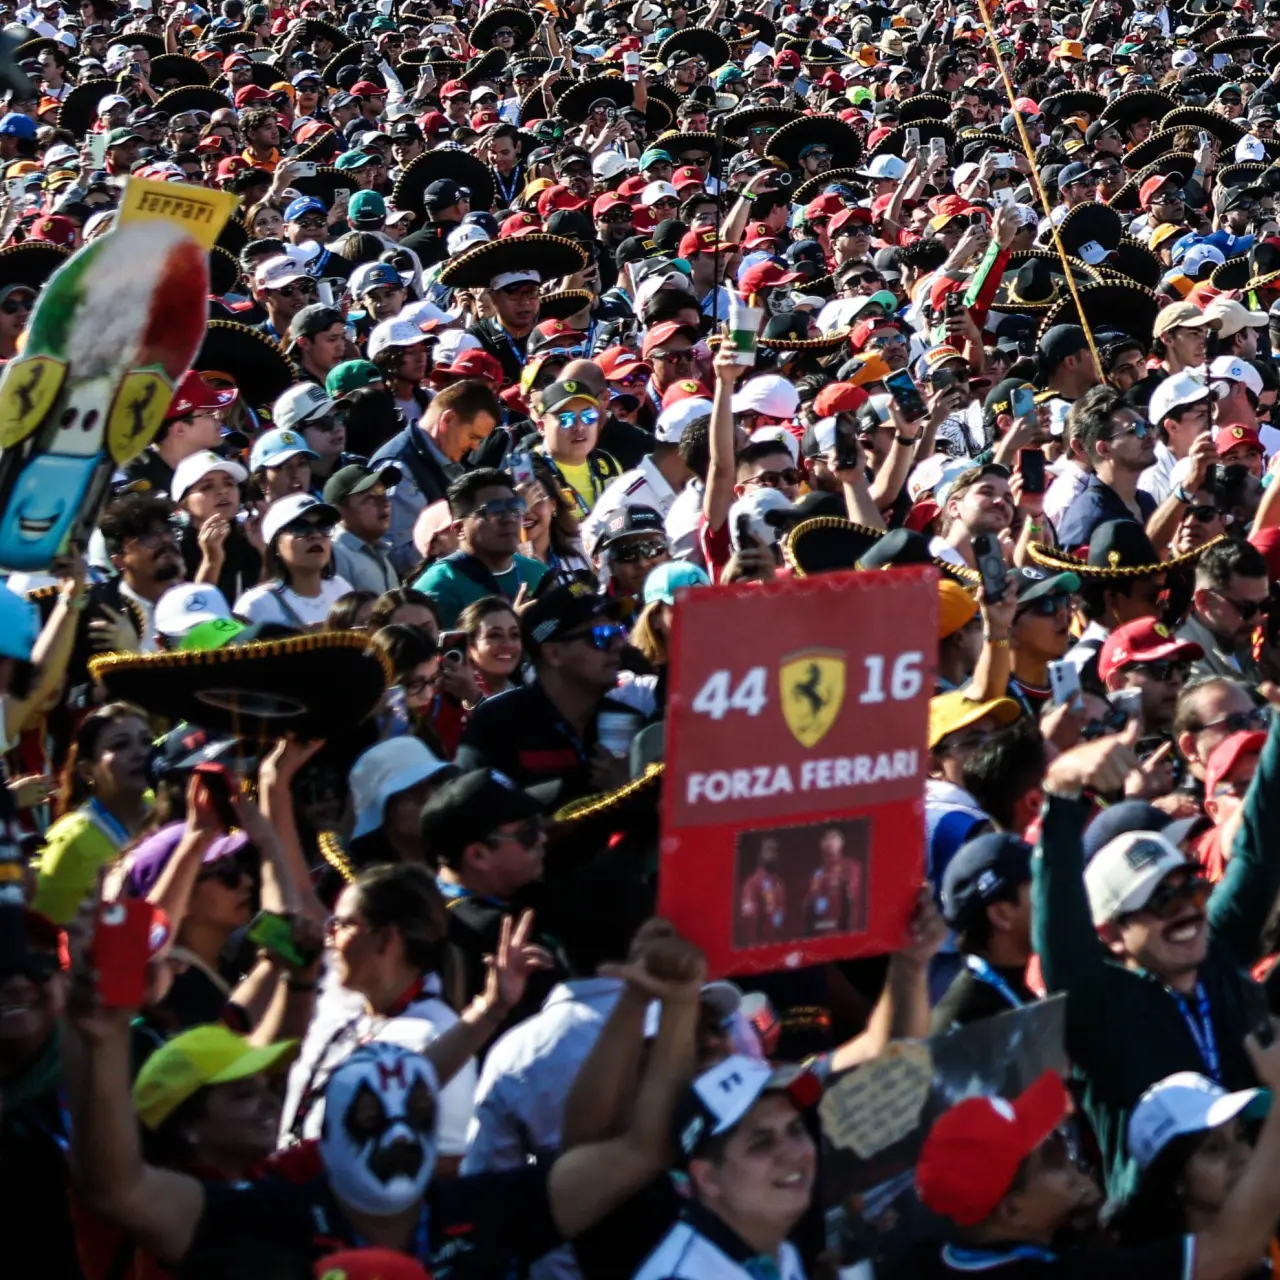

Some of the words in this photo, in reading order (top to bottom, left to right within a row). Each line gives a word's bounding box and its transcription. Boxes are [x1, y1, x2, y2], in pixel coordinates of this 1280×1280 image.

[138, 191, 215, 225] Ferrari
[692, 668, 770, 720] 44
[859, 651, 924, 703] 16
[687, 764, 793, 805] FORZA
[801, 750, 919, 791] FERRARI
